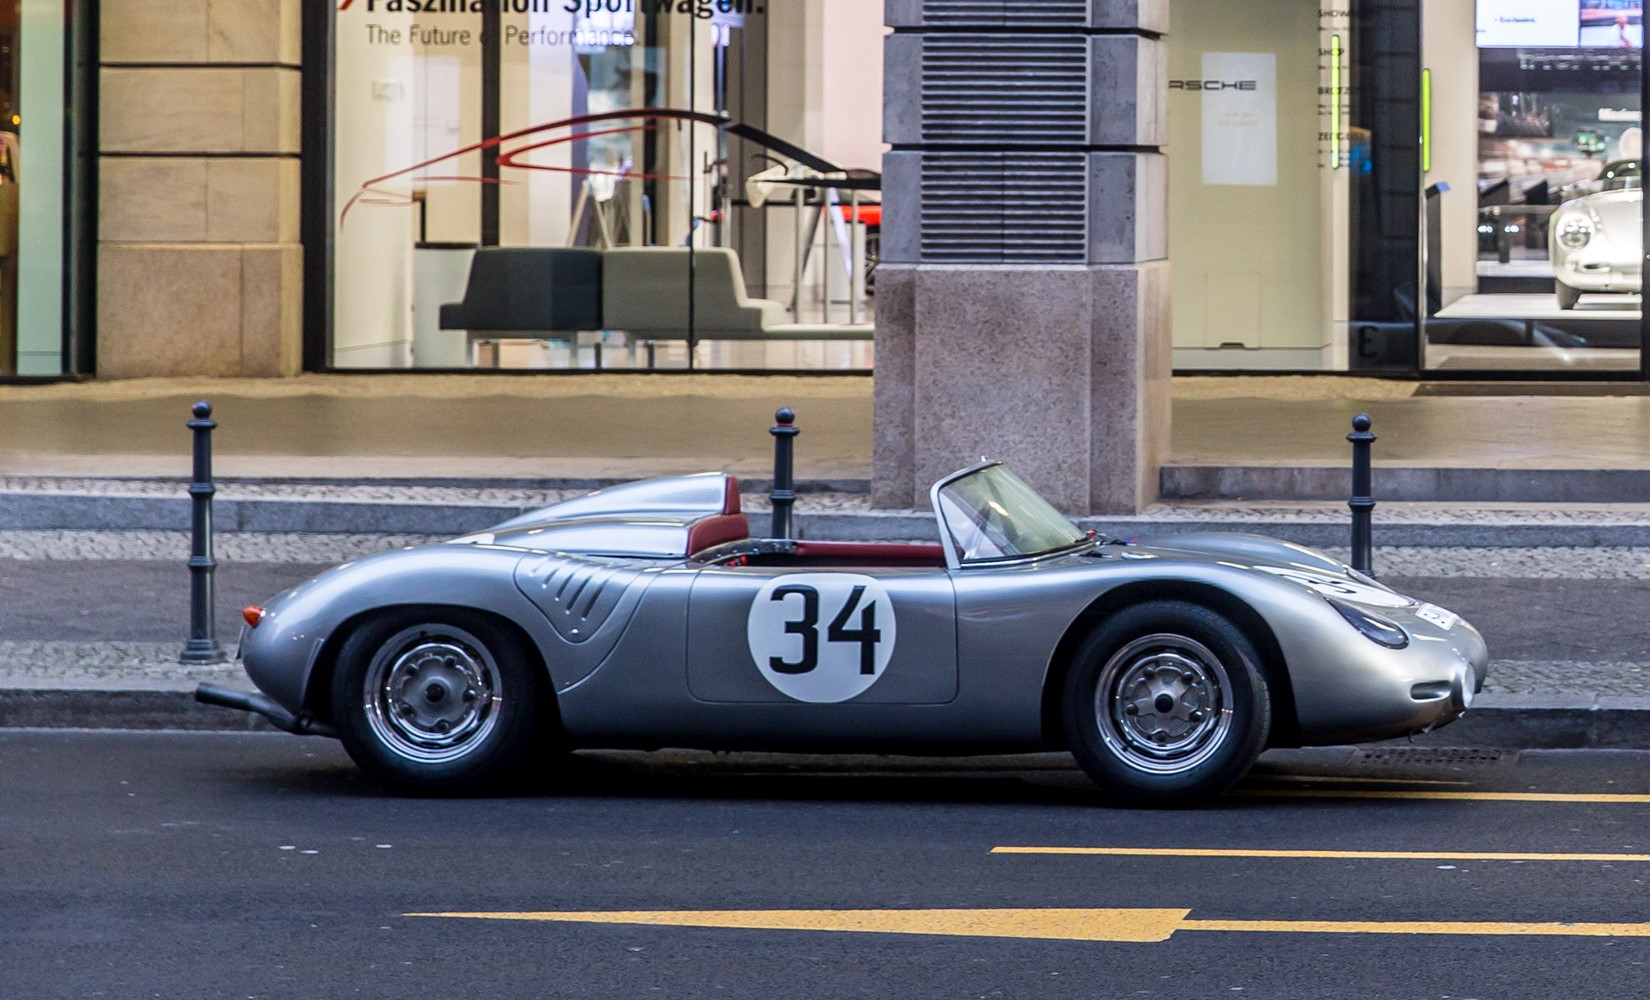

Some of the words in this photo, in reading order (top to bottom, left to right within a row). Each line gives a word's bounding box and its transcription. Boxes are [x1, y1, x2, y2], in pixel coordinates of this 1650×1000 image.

[366, 24, 401, 45] The
[409, 24, 471, 45] Future
[768, 583, 882, 676] 34
